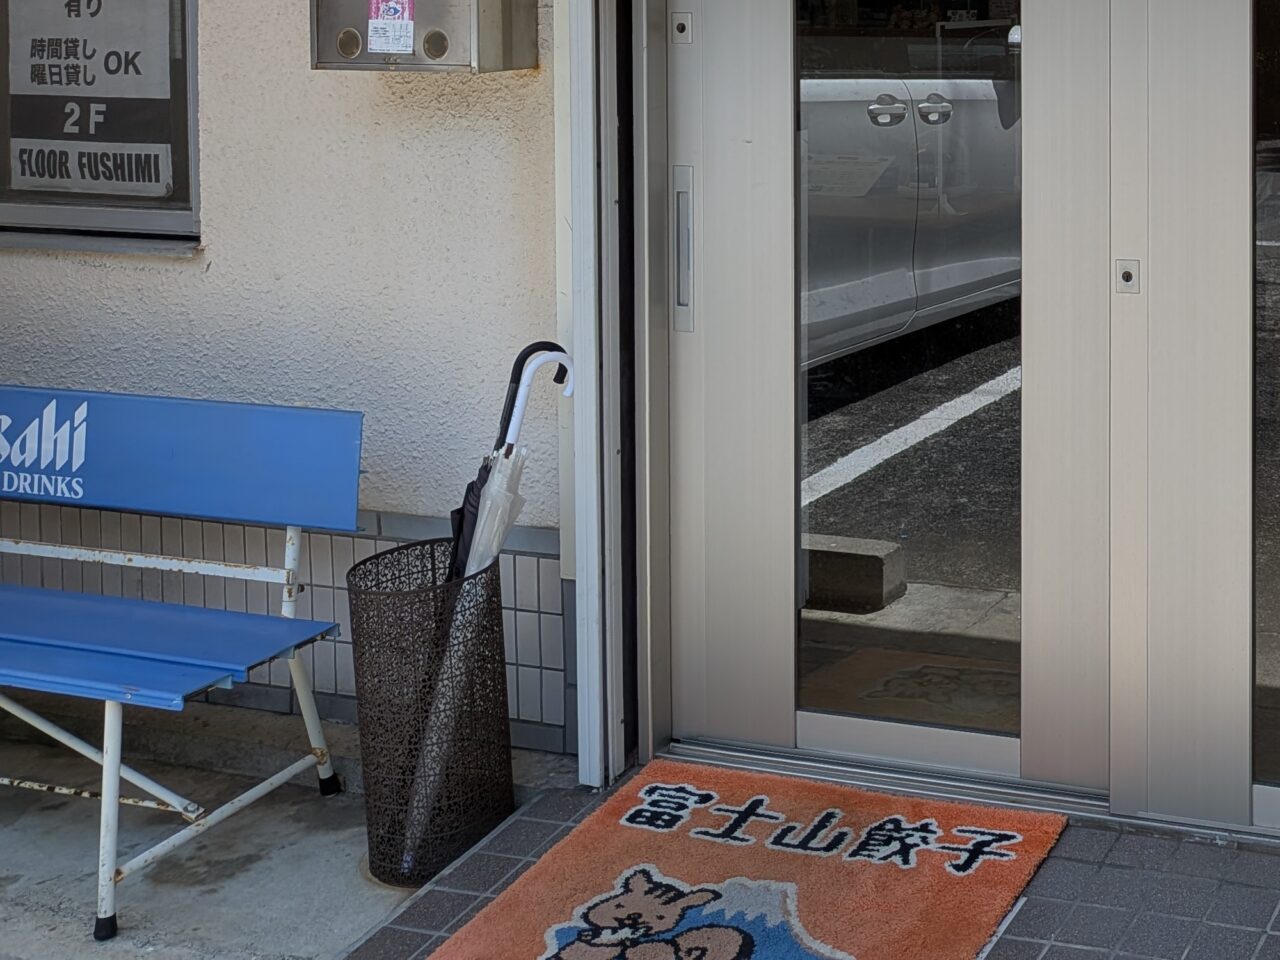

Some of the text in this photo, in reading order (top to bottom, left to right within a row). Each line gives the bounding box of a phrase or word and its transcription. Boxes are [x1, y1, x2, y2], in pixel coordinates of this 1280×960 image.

[30, 38, 97, 61] 時間貸し
[103, 50, 143, 75] OK
[30, 63, 97, 87] 曜日貸し
[18, 147, 161, 183] FLOOR FUSHIMI
[2, 471, 84, 499] DRINKS
[622, 782, 1020, 874] 富士山餃子
